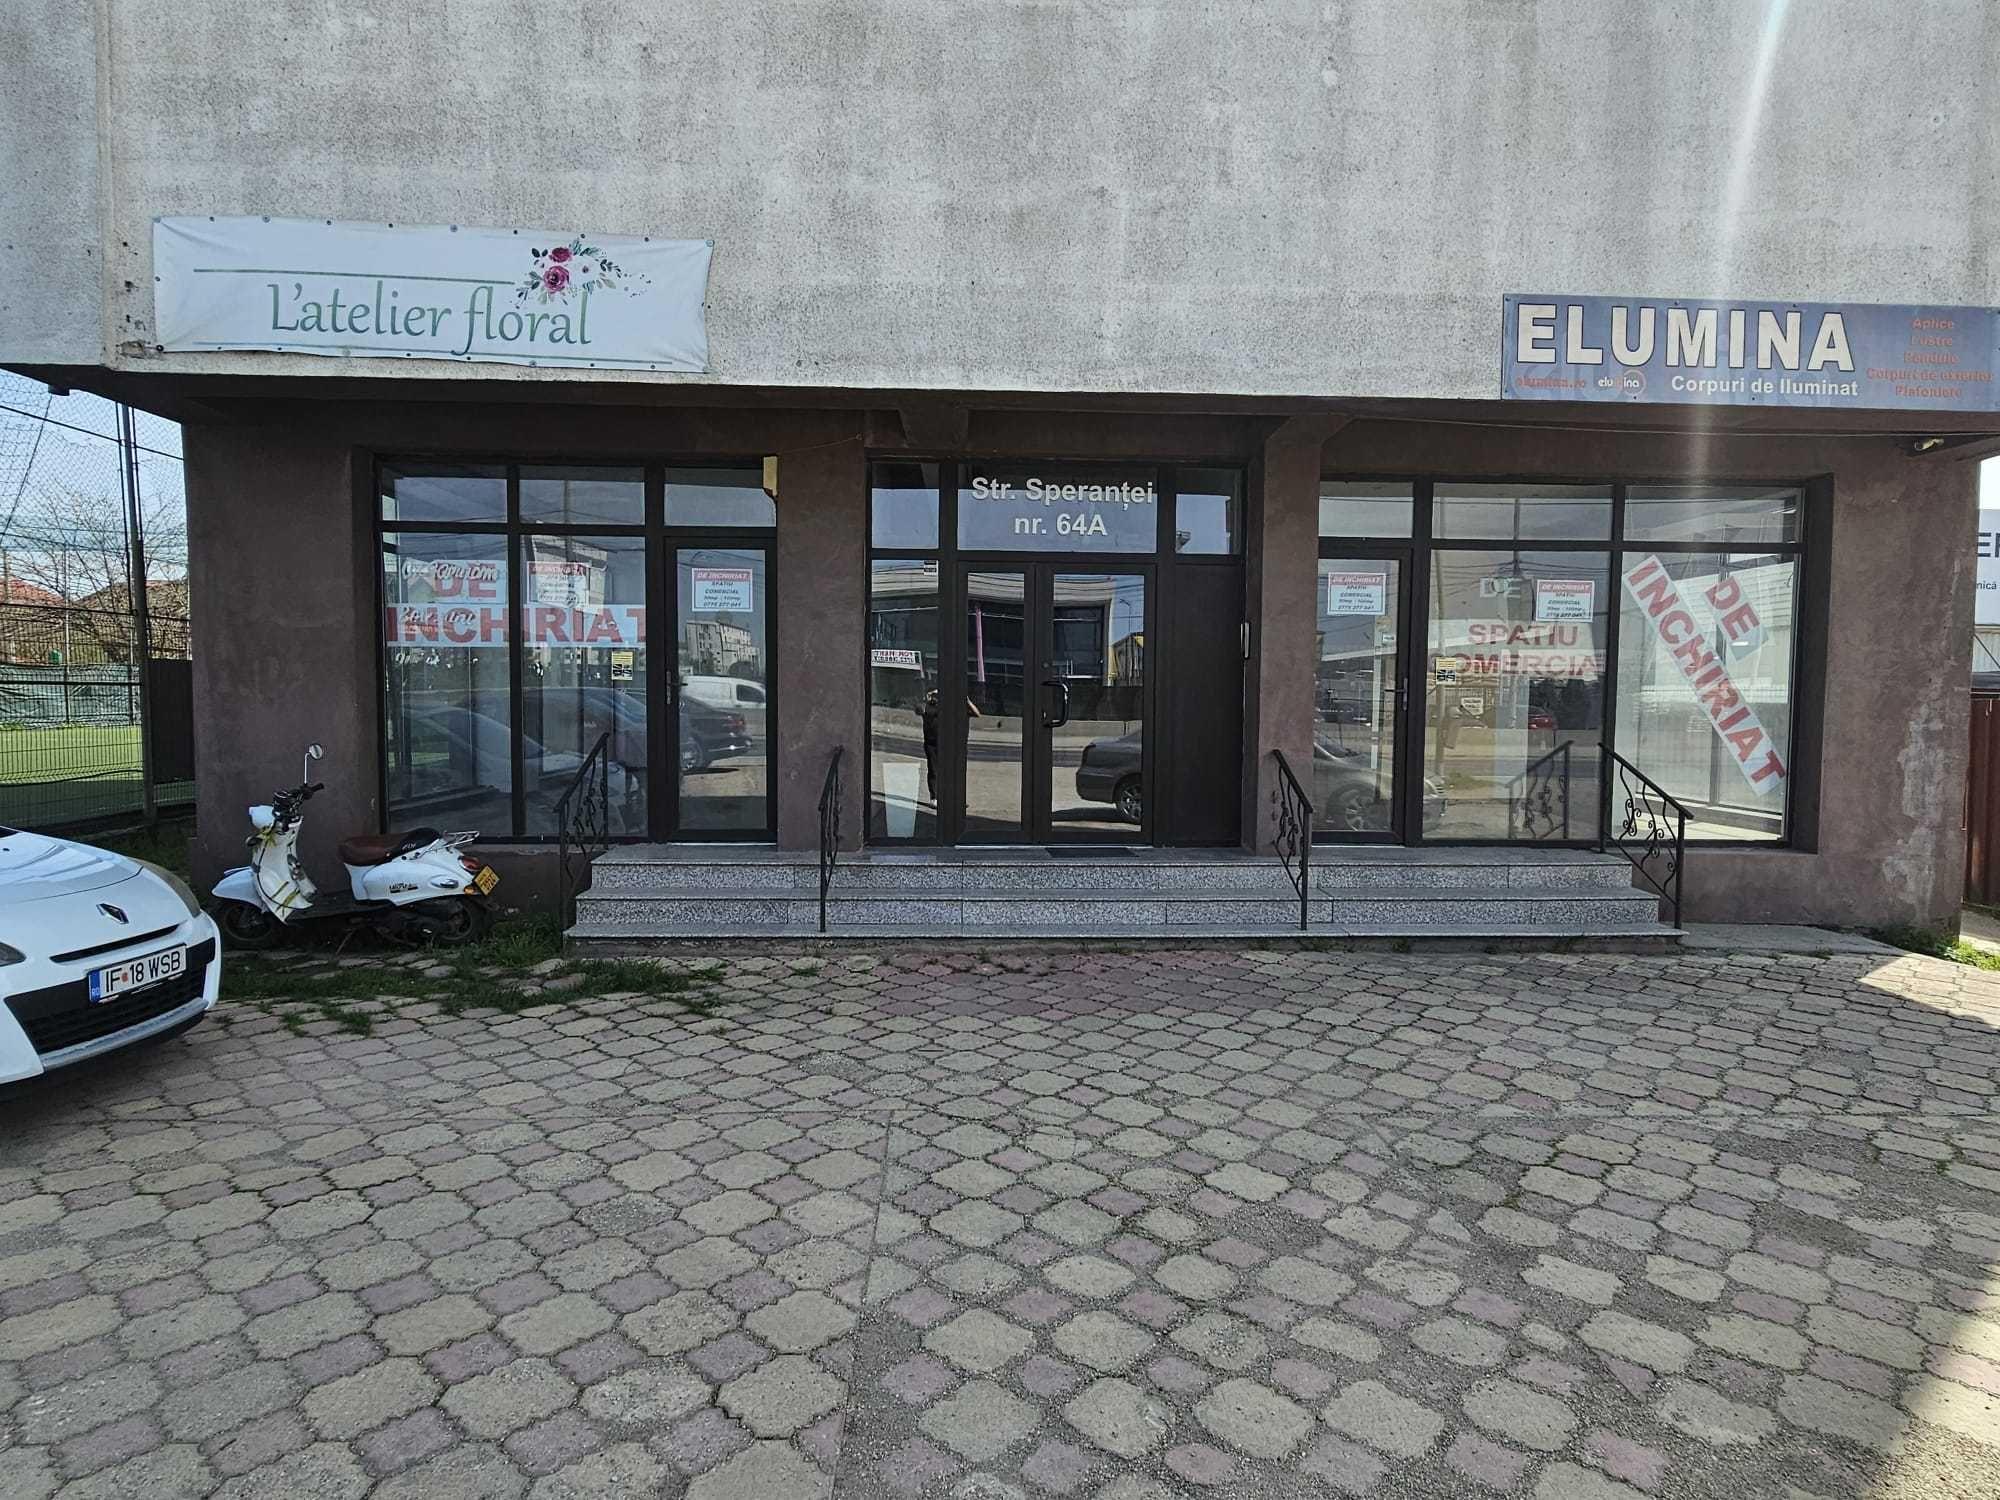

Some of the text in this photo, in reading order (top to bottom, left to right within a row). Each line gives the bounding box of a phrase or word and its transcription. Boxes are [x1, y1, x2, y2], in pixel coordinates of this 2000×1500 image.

[267, 281, 592, 356] L'atelier floral
[1516, 302, 1855, 372] ELUMINA
[1671, 375, 1858, 396] Corpuri de Iluminat
[971, 477, 1017, 500] Str.
[1014, 513, 1108, 536] nr. 64A
[434, 562, 497, 598] DE
[386, 607, 646, 643] INCHIRIAT
[1704, 576, 1761, 641] DE
[1468, 623, 1578, 647] SPATIU
[1627, 561, 1786, 784] INCHIRIAT
[105, 951, 181, 993] IF 18 WSB
